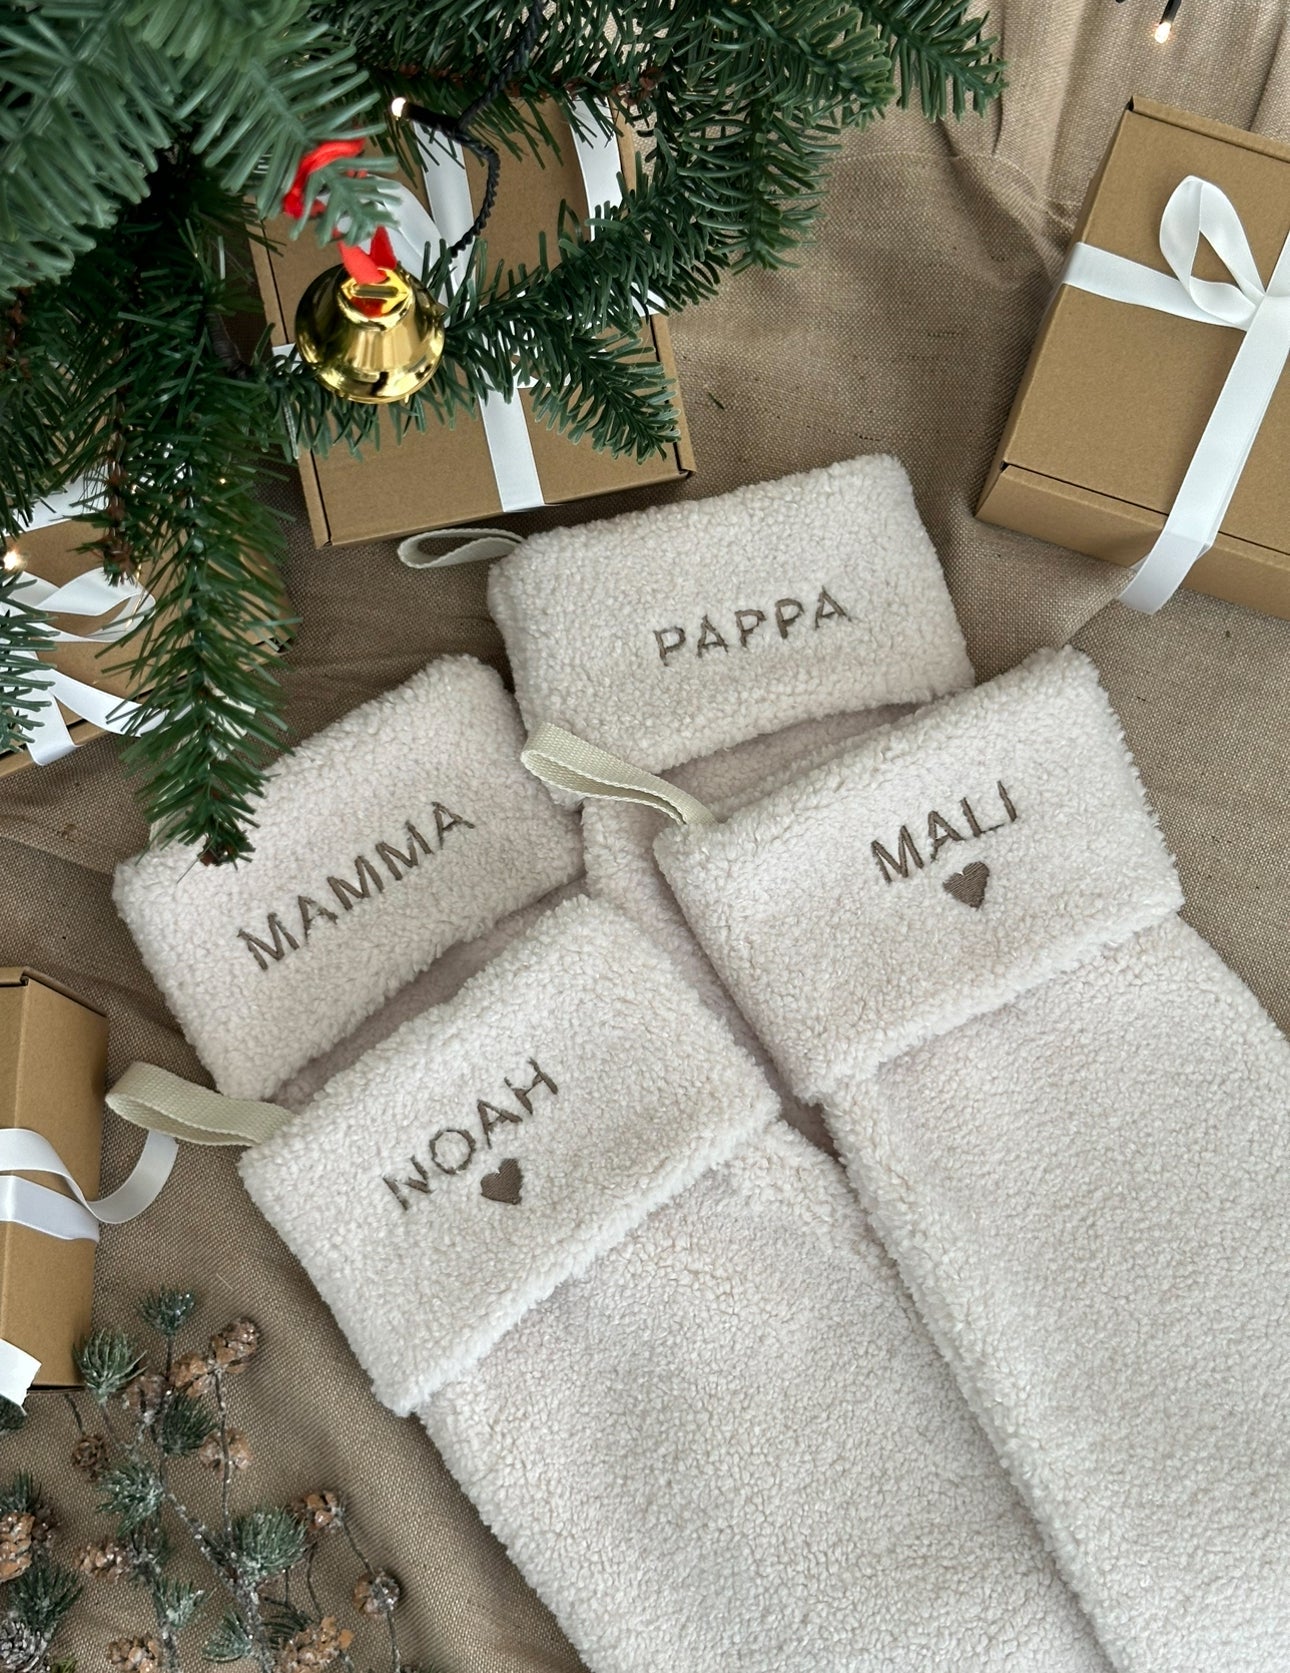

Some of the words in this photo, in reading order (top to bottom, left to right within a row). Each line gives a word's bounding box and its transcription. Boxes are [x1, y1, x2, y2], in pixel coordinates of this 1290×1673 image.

[653, 585, 852, 667] PAPPA
[236, 801, 476, 972] MAMMA
[870, 780, 1018, 884] MALI
[382, 1057, 559, 1211] NOAH
